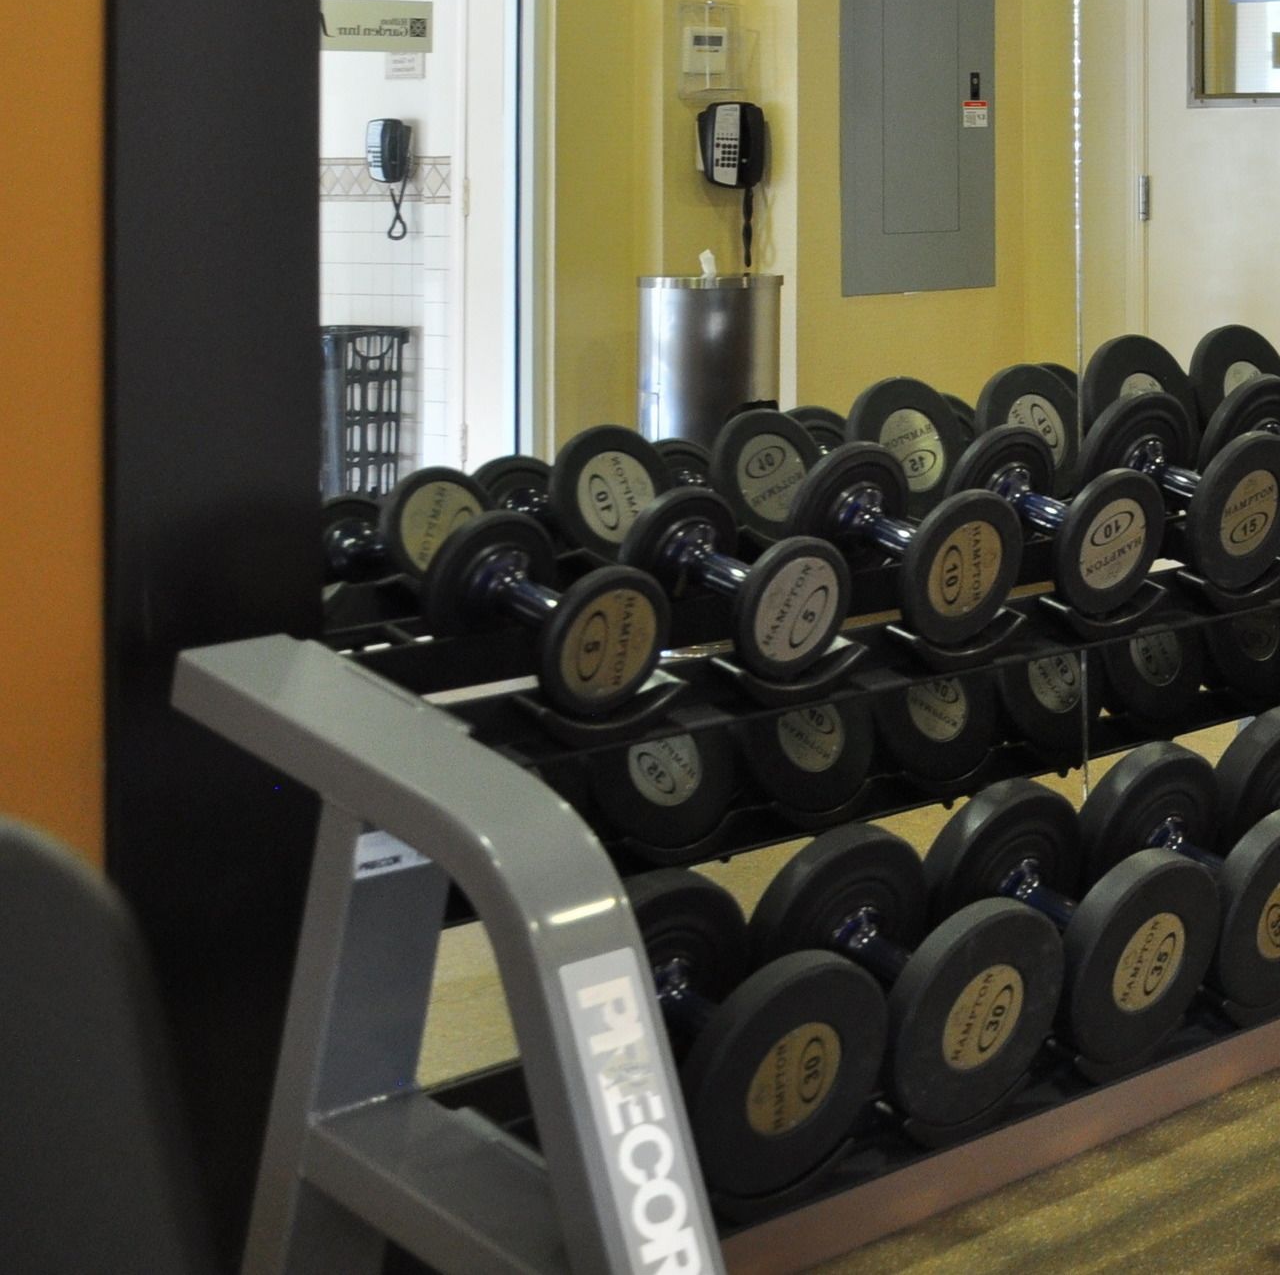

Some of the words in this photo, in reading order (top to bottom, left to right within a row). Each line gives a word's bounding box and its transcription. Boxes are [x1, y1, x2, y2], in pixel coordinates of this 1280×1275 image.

[1225, 485, 1274, 517] HAMPTON
[1103, 519, 1120, 539] 10
[1242, 519, 1257, 536] 15
[969, 526, 982, 601] HAMPTON
[1086, 535, 1142, 576] HAMPTON
[944, 563, 959, 588] 10
[762, 564, 814, 647] HAMPTON
[802, 609, 817, 623] 5
[612, 596, 636, 686] HAMPTON
[1120, 921, 1160, 1003] HAMPTON
[1151, 952, 1169, 977] 35
[951, 973, 994, 1061] HAMPTON
[986, 1005, 1006, 1032] 30
[804, 1055, 821, 1085] 30
[576, 976, 702, 1275] PRECOR
